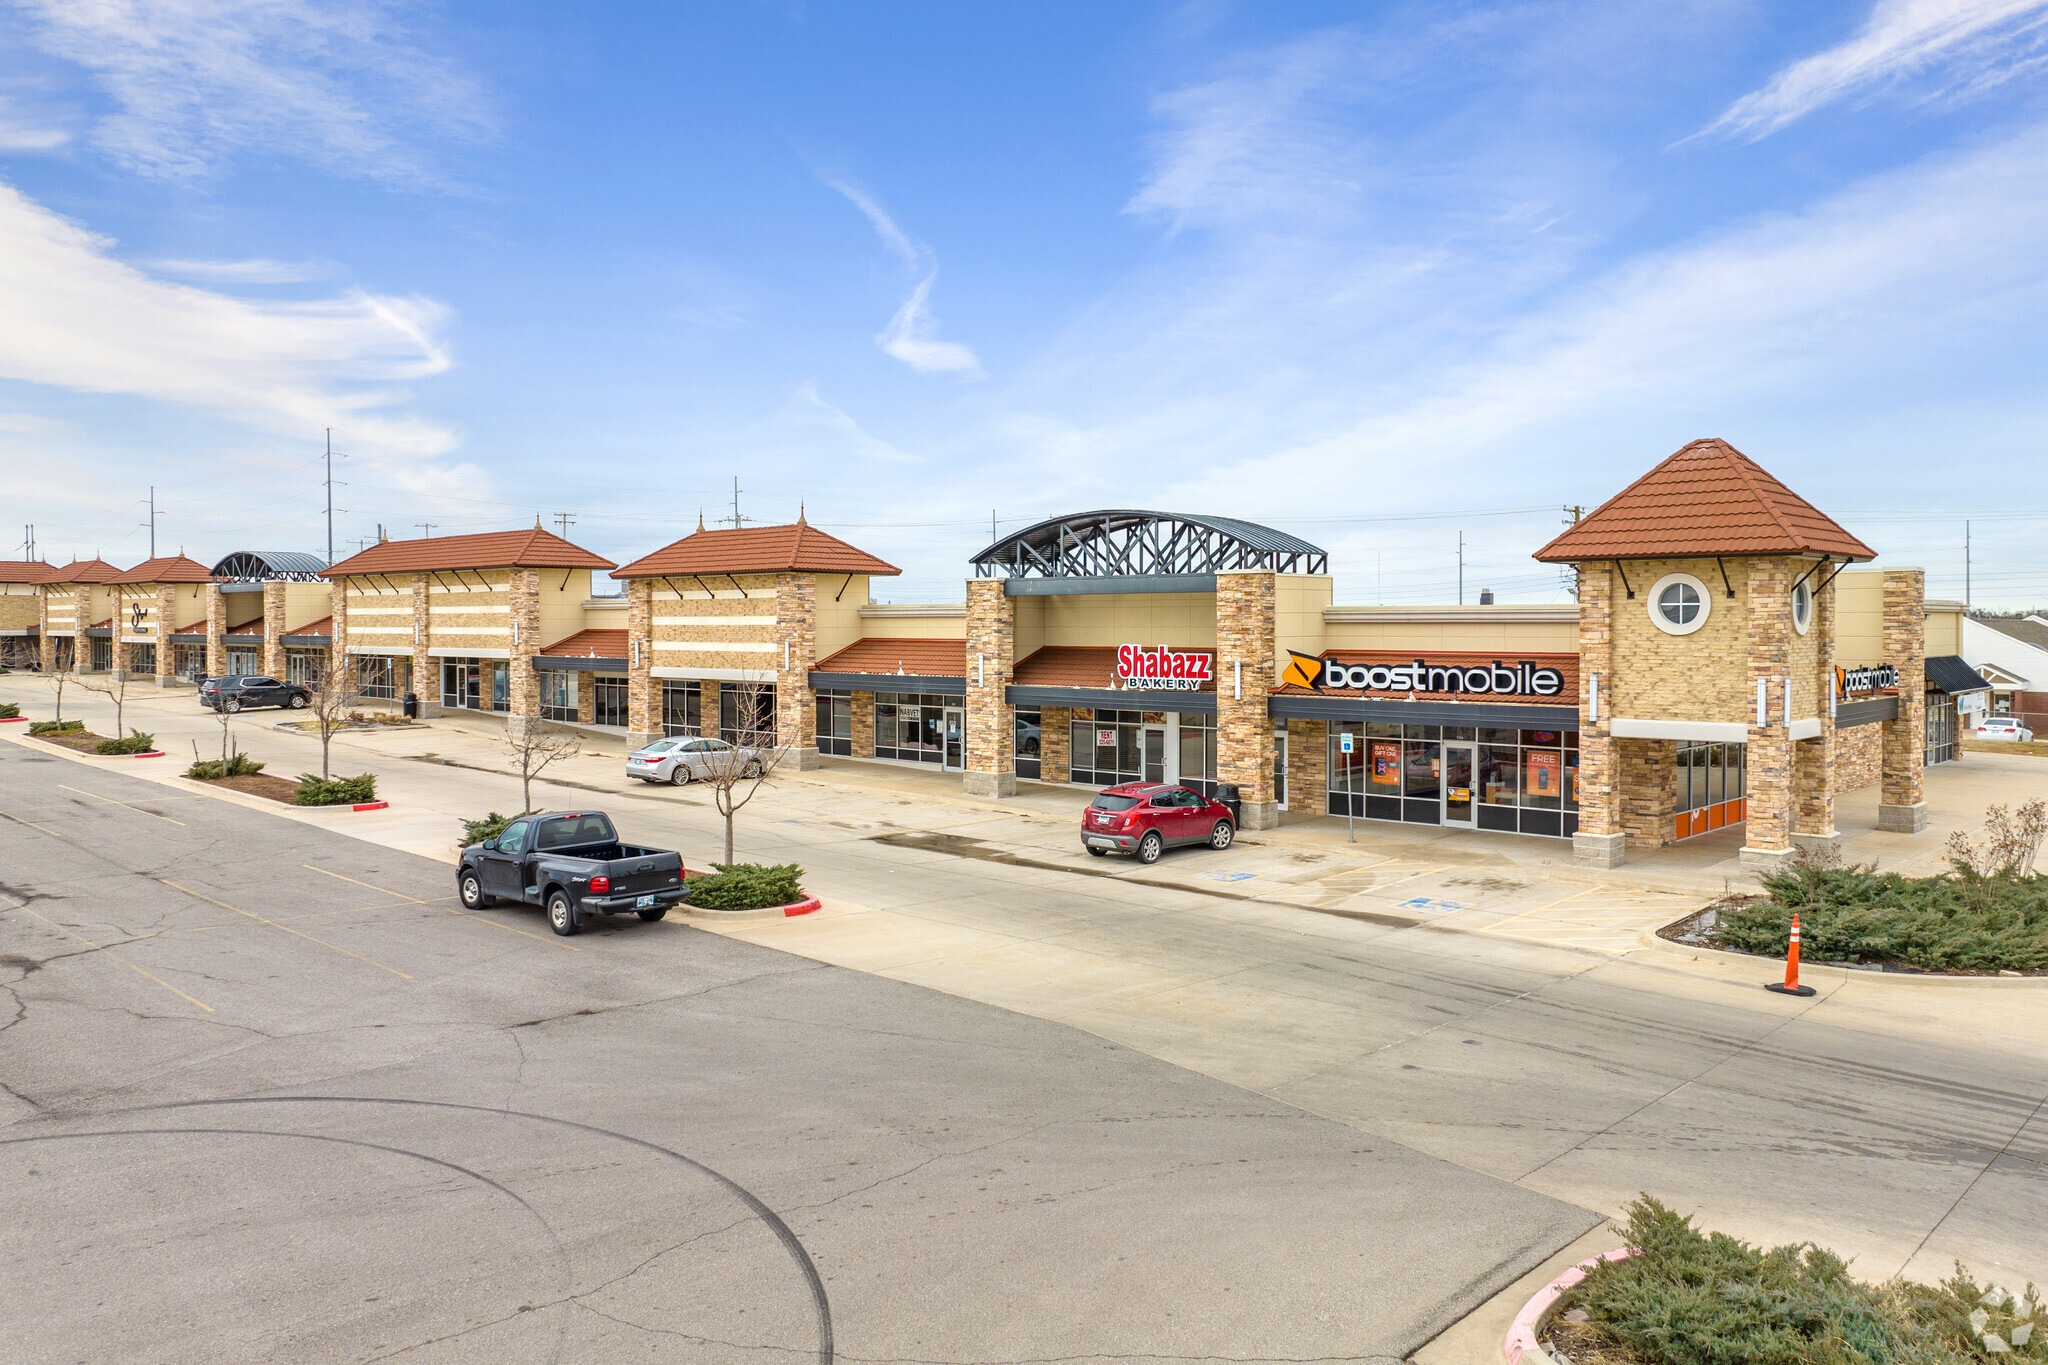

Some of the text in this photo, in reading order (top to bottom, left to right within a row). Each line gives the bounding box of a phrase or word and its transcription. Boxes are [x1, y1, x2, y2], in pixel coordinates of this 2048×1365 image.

[1118, 644, 1210, 679] Shabazz
[1129, 678, 1199, 689] BAKERY
[1531, 754, 1555, 764] FREE
